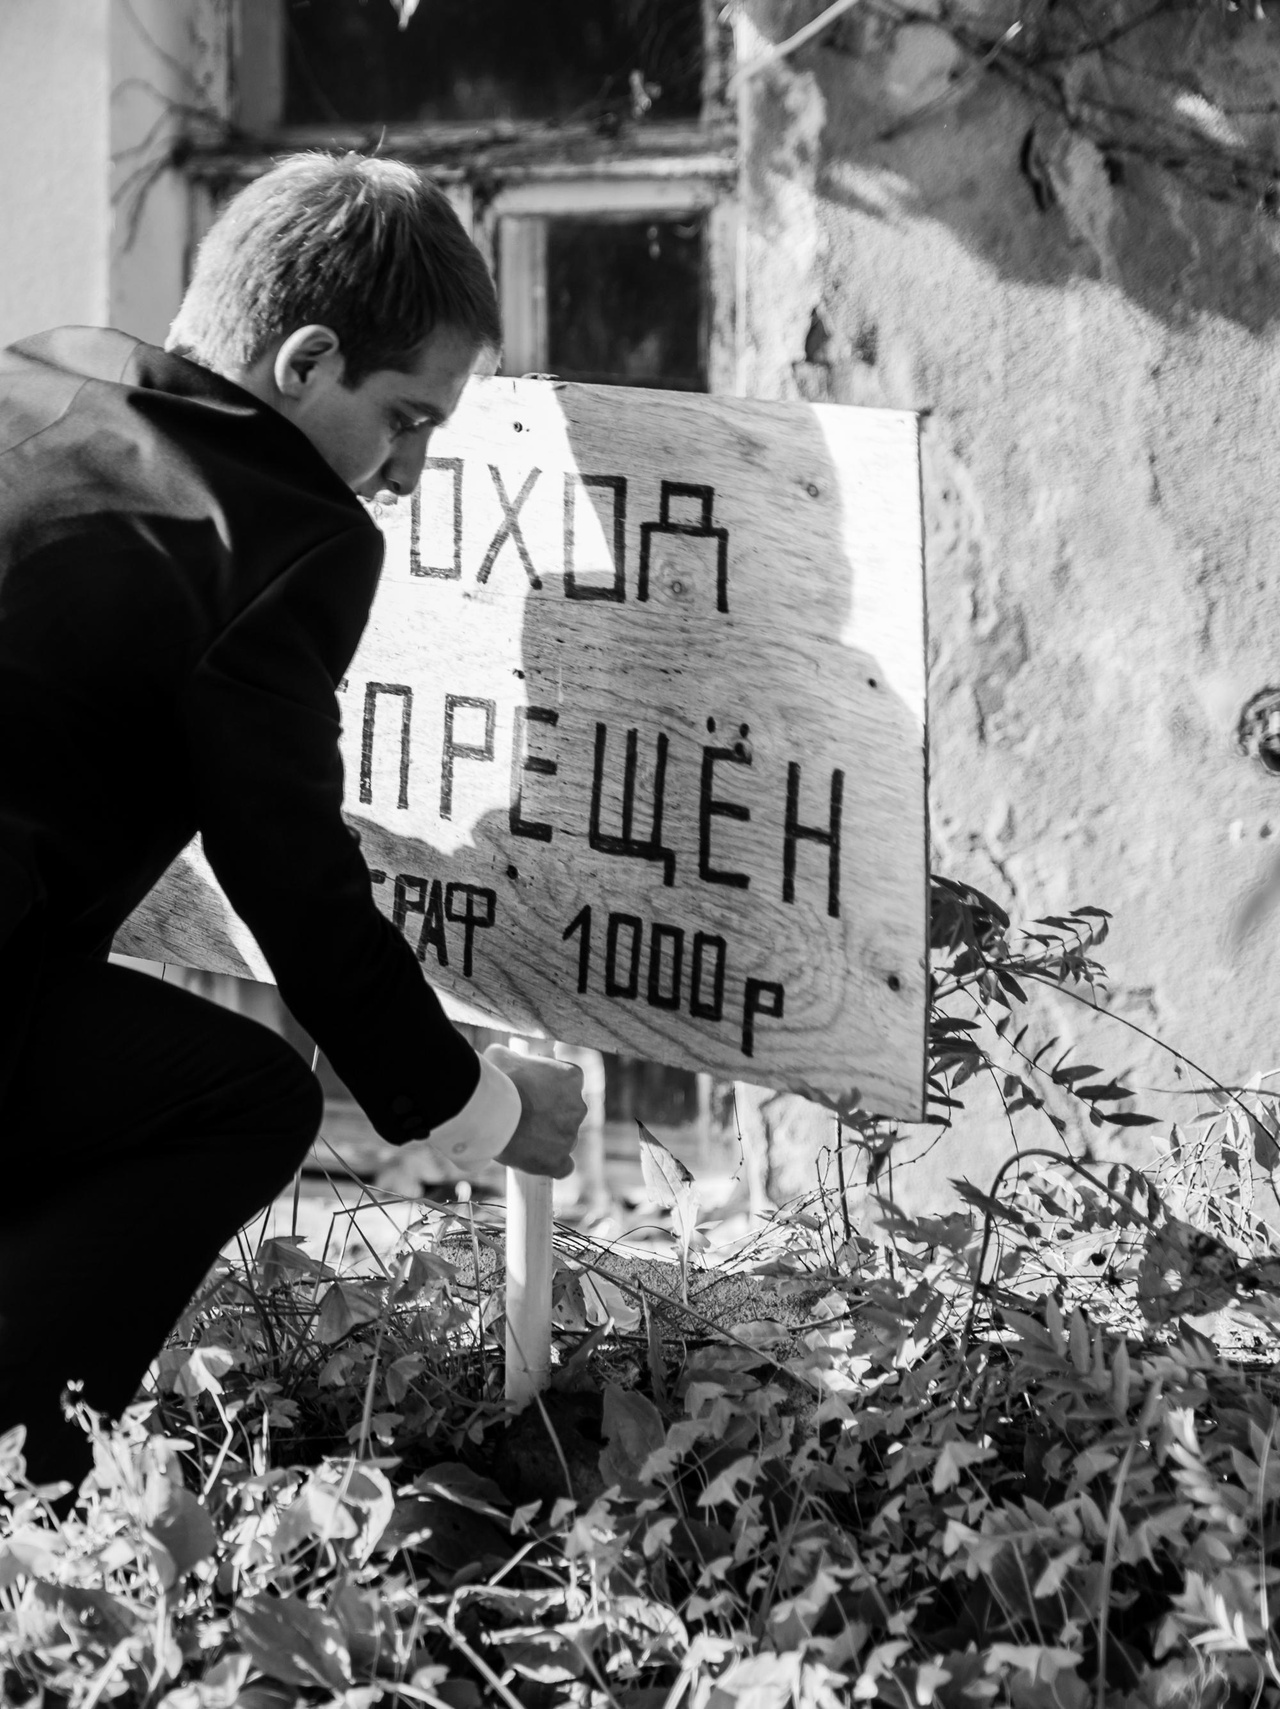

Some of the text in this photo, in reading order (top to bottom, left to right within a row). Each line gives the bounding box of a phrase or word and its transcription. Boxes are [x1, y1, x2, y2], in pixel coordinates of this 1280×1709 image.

[410, 456, 729, 614] ОХОД
[335, 676, 845, 919] ПРЕЩЁН
[370, 868, 497, 978] РАФ
